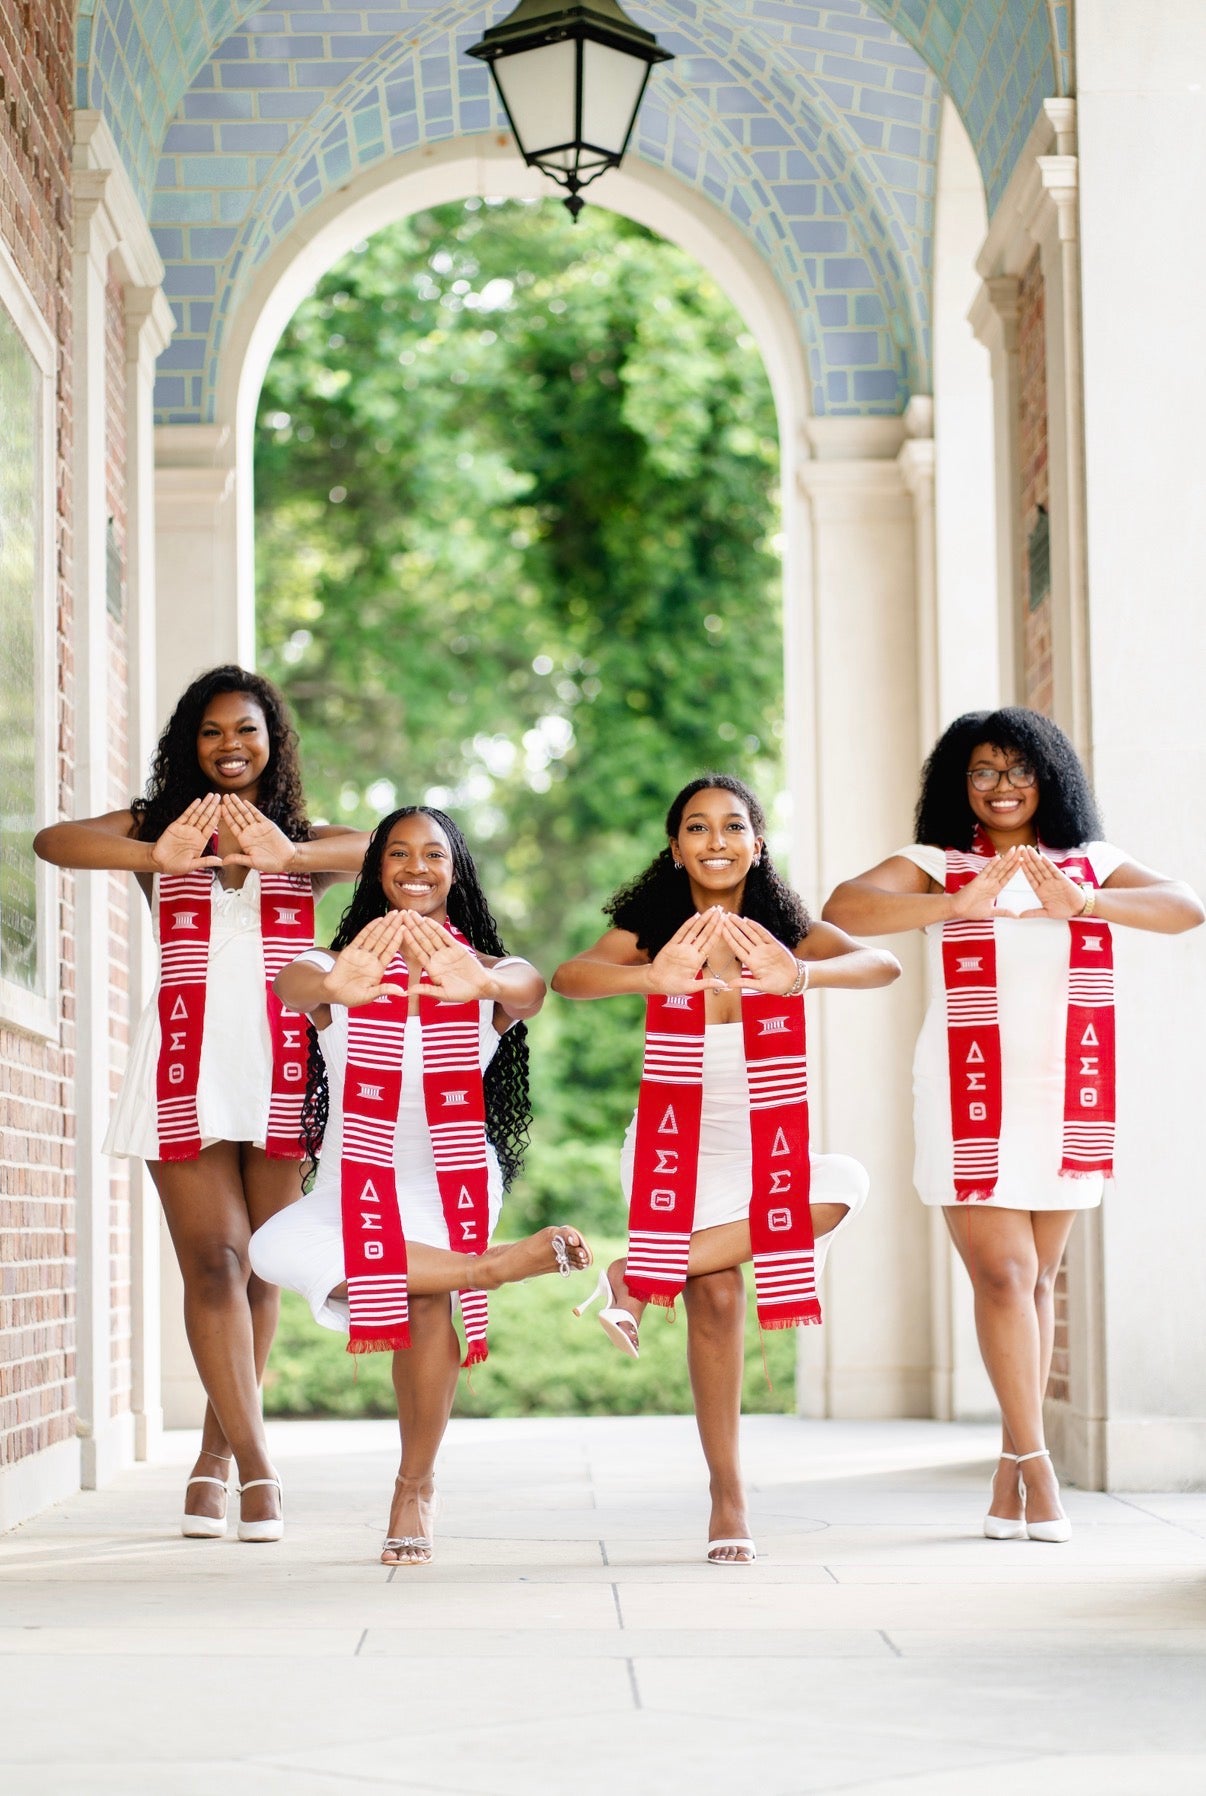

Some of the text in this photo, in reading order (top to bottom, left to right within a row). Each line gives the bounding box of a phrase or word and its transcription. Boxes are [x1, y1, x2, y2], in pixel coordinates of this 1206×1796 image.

[168, 994, 188, 1084] ΔΣΘ
[965, 1040, 987, 1121] ΔΣΘ
[1079, 1022, 1100, 1108] ΔΣΘ
[649, 1103, 679, 1212] ΔΣΘ
[767, 1126, 793, 1232] ΔΣΘ
[359, 1178, 384, 1260] ΔΣΘ
[457, 1184, 478, 1256] ΔΣ
